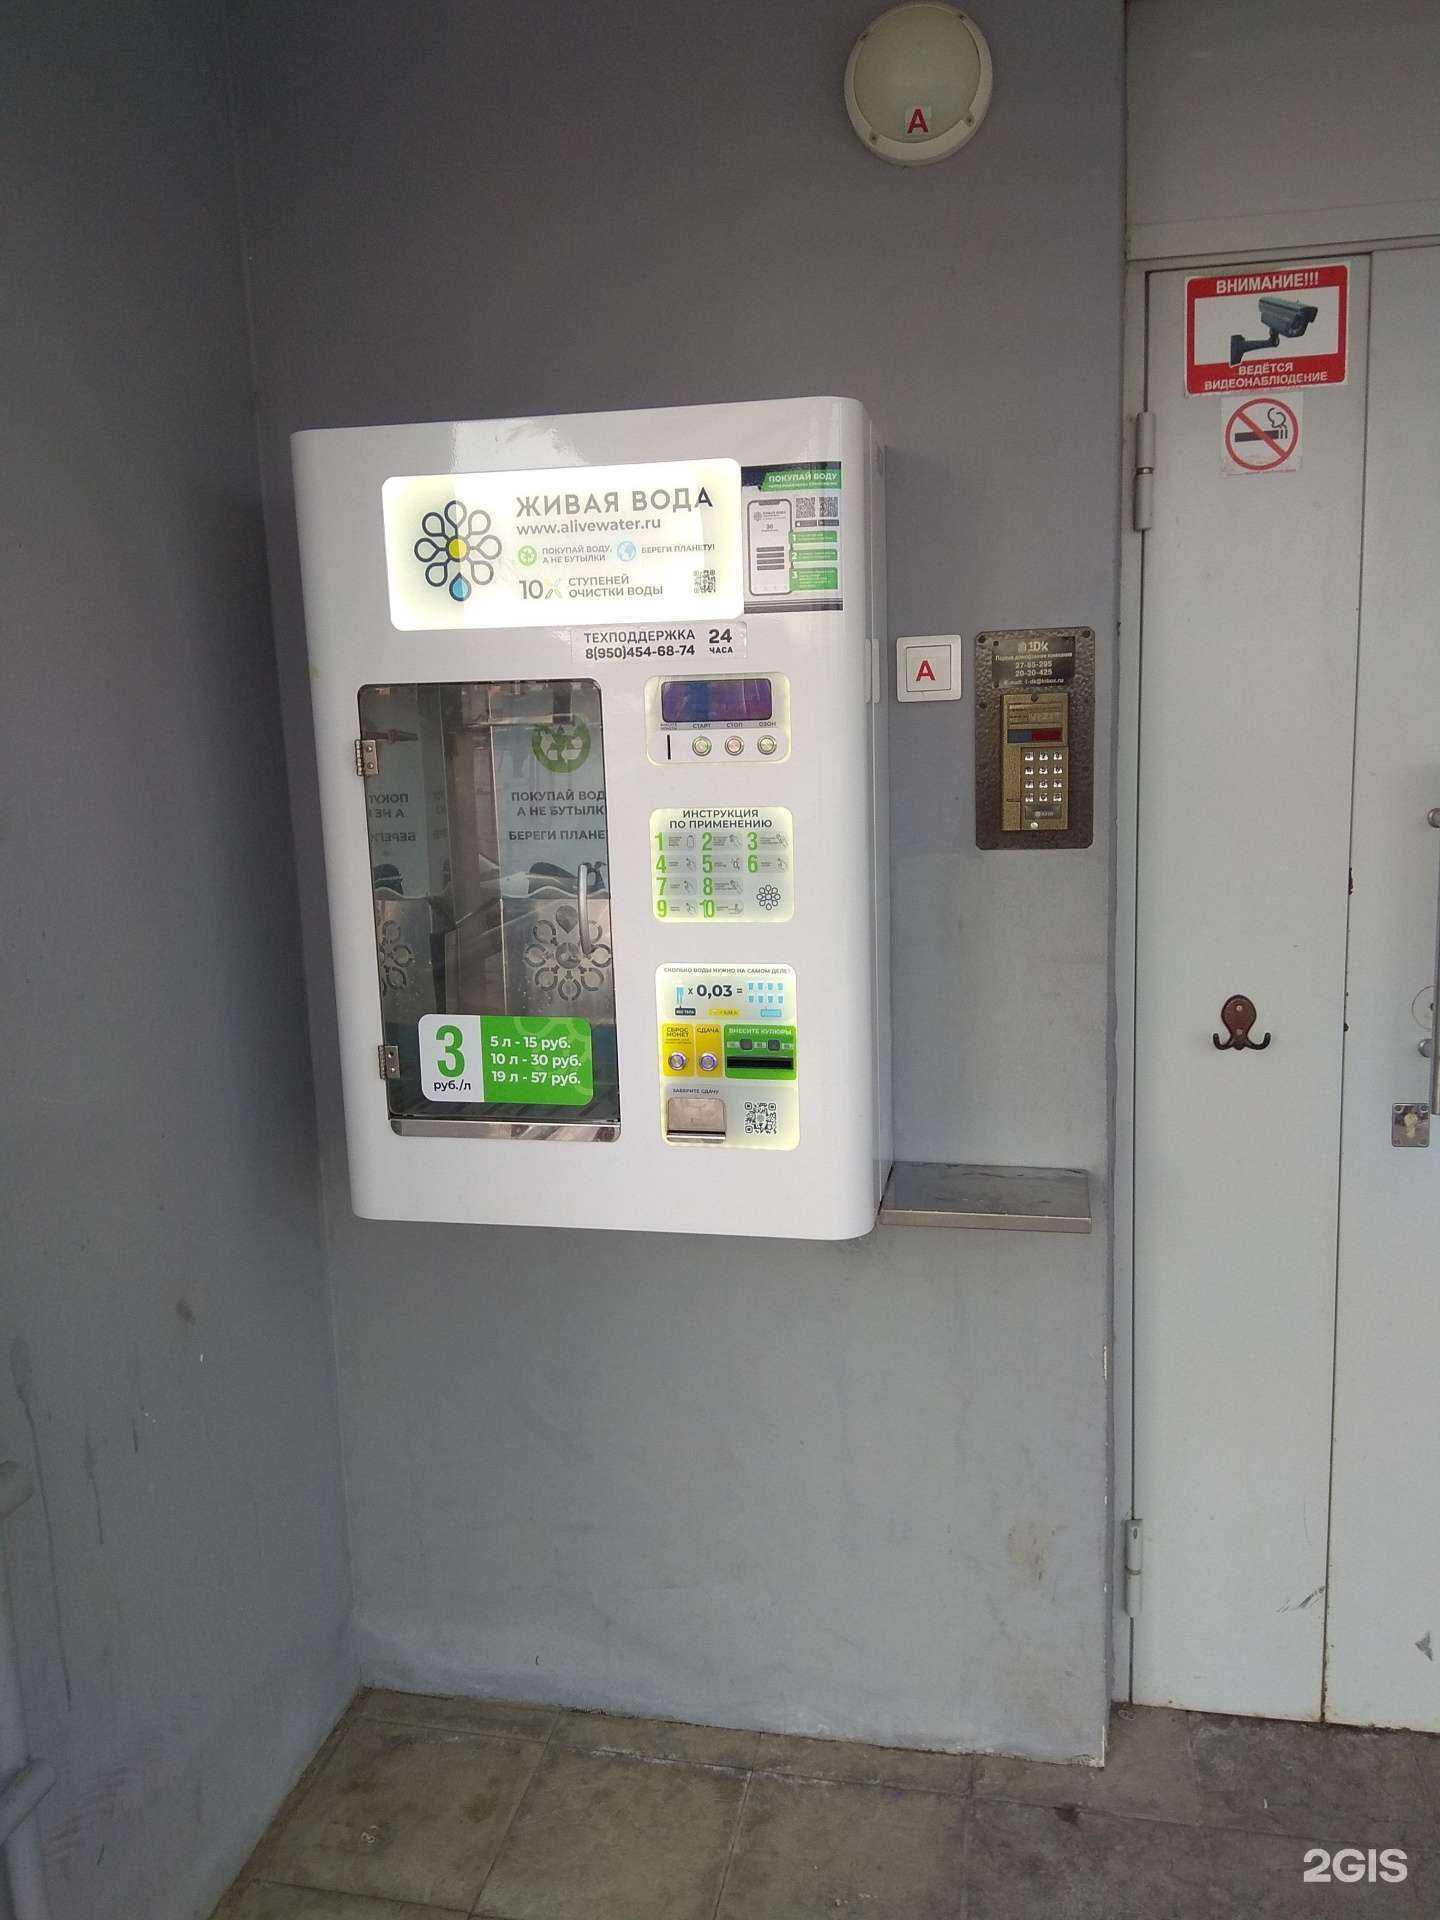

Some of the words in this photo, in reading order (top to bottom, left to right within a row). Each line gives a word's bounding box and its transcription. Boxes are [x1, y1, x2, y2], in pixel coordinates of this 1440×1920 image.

[1216, 272, 1319, 294] ВНИМАНИЕ!!!
[1238, 361, 1293, 376] ВЕДЁТСЯ
[1204, 371, 1328, 391] ВИДЕОНАБЛЮДЕНИЕ
[768, 472, 812, 483] ПОКУПАЙ
[813, 472, 837, 481] ВОДУ
[516, 492, 619, 517] ЖИВАЯ
[632, 487, 713, 513] ВОДА
[516, 518, 661, 535] www.alivewater.ru
[542, 545, 584, 554] ПОКУПАЙ
[641, 546, 672, 554] БЕРЕГИ
[674, 543, 715, 553] ПЛАНЕТУ!
[791, 552, 798, 560] 2
[551, 556, 563, 564] НЕ
[564, 554, 605, 563] БУТЫЛКИ
[568, 573, 629, 587] СТУПЕНЕЙ
[791, 571, 798, 579] 3
[519, 579, 544, 600] 10
[568, 588, 624, 599] ОЧИСТКИ
[628, 585, 663, 597] ВОДЫ
[584, 629, 695, 644] ТЕХПОДДЕРЖКА
[708, 629, 733, 644] 24
[585, 645, 695, 661] 8(950)454-68-74
[709, 646, 733, 654] ЧАСА
[511, 789, 574, 802] ПОКУПАЙ
[517, 807, 526, 816] А
[529, 807, 546, 816] НЕ
[550, 805, 606, 816] БУТЫЛК
[683, 809, 759, 819] ИНСТРУКЦИЯ
[669, 820, 686, 829] ПО
[689, 819, 772, 829] ПРИМЕНЕНИЮ
[509, 831, 556, 841] БЕРЕГИ
[655, 832, 663, 851] 1
[702, 832, 712, 851] 2
[747, 831, 757, 850] 3
[656, 854, 666, 873] 4
[702, 854, 713, 873] 5
[747, 854, 758, 873] 6
[656, 877, 667, 896] 7
[703, 877, 713, 896] 8
[657, 899, 667, 918] 9
[699, 899, 715, 918] 10
[697, 984, 733, 999] 0,03
[761, 1028, 792, 1036] КУПЮРЫ
[435, 1024, 465, 1078] 3
[490, 1036, 499, 1047] 5
[501, 1038, 511, 1048] л
[523, 1036, 537, 1048] 15
[541, 1036, 571, 1051] руб.
[491, 1053, 506, 1065] 10
[509, 1055, 518, 1065] л
[531, 1054, 548, 1066] 30
[552, 1055, 582, 1069] руб.
[433, 1079, 471, 1091] руб./л
[492, 1071, 506, 1082] 19
[509, 1073, 518, 1083] л
[531, 1072, 548, 1084] 57
[551, 1073, 581, 1087] руб.
